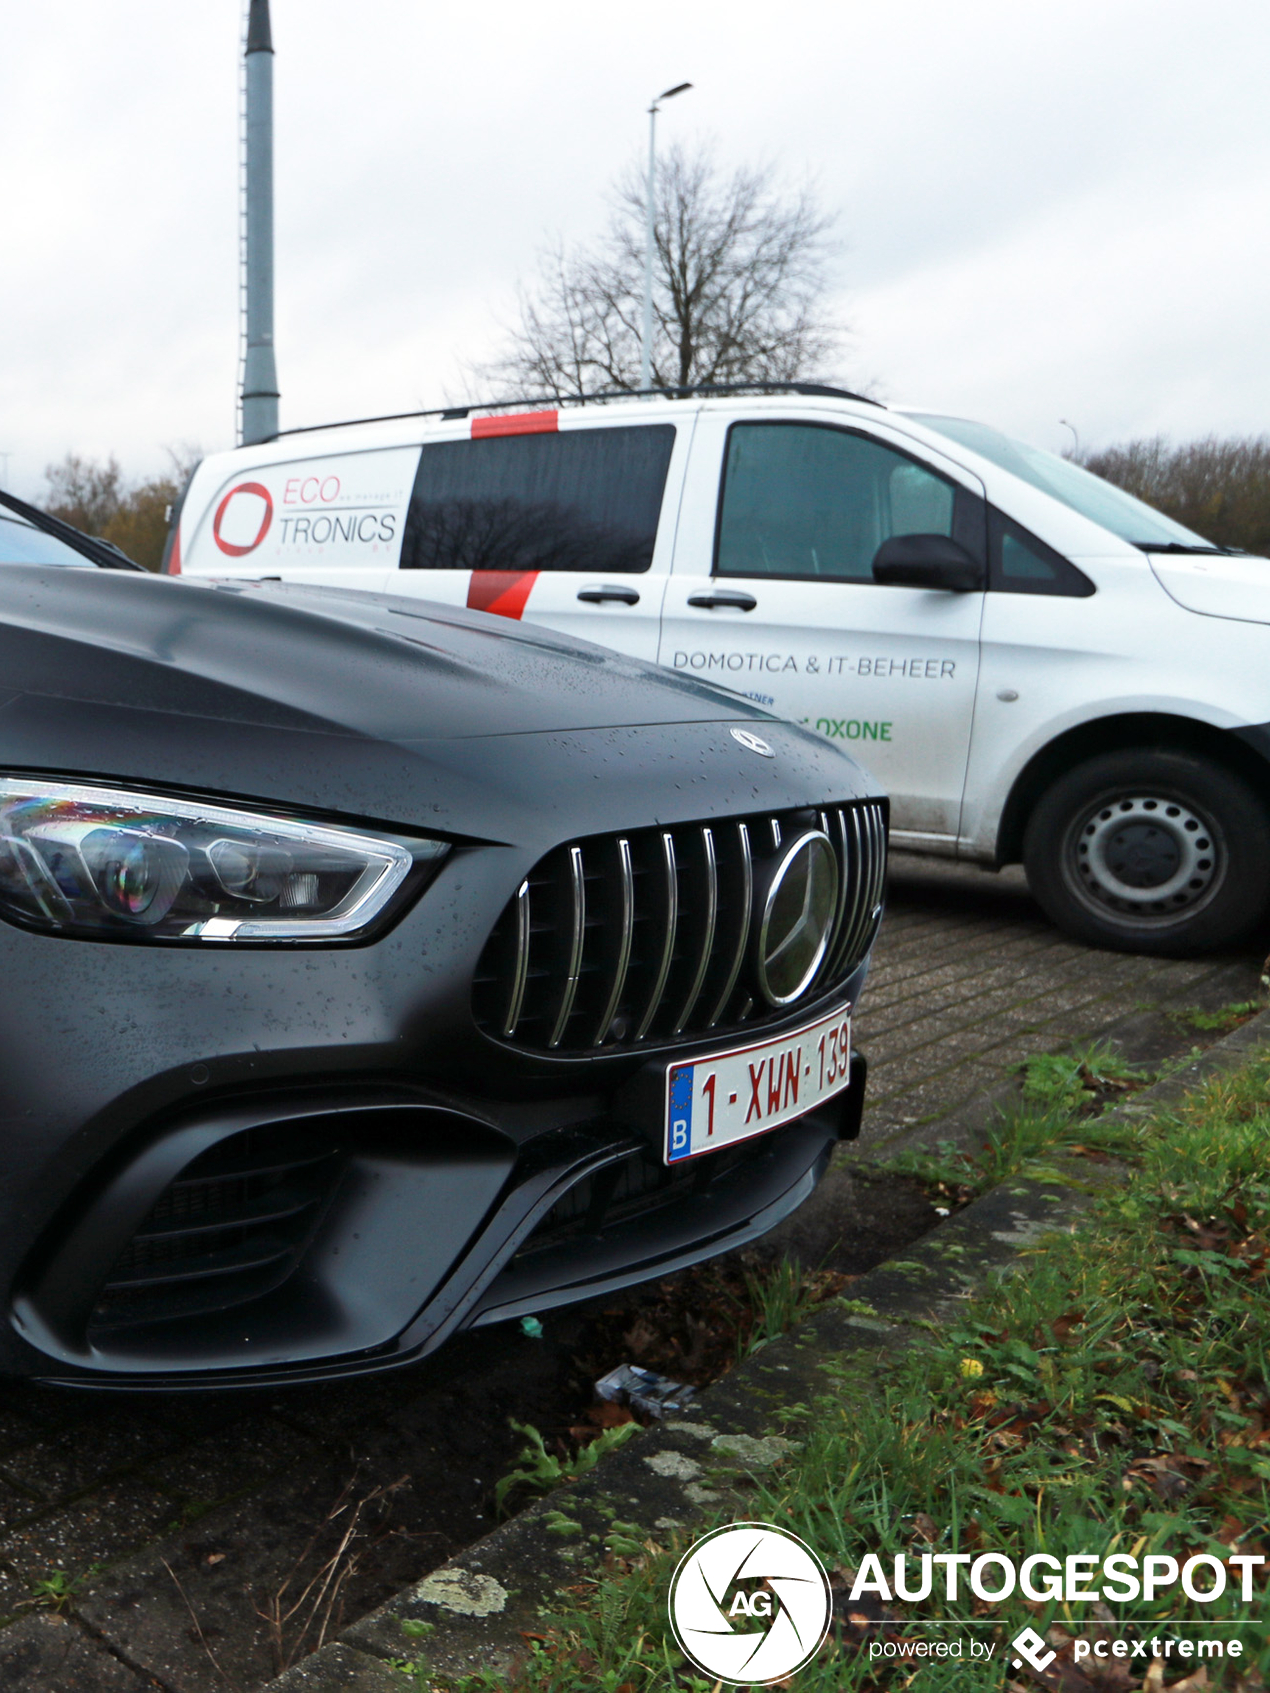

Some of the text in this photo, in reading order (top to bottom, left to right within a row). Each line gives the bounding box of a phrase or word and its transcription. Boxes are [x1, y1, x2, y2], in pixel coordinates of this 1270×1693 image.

[283, 475, 341, 505] ECO
[279, 513, 397, 545] TRONICS
[673, 651, 957, 680] DOMOTICA & IT-BEHEER
[672, 1119, 687, 1151] B
